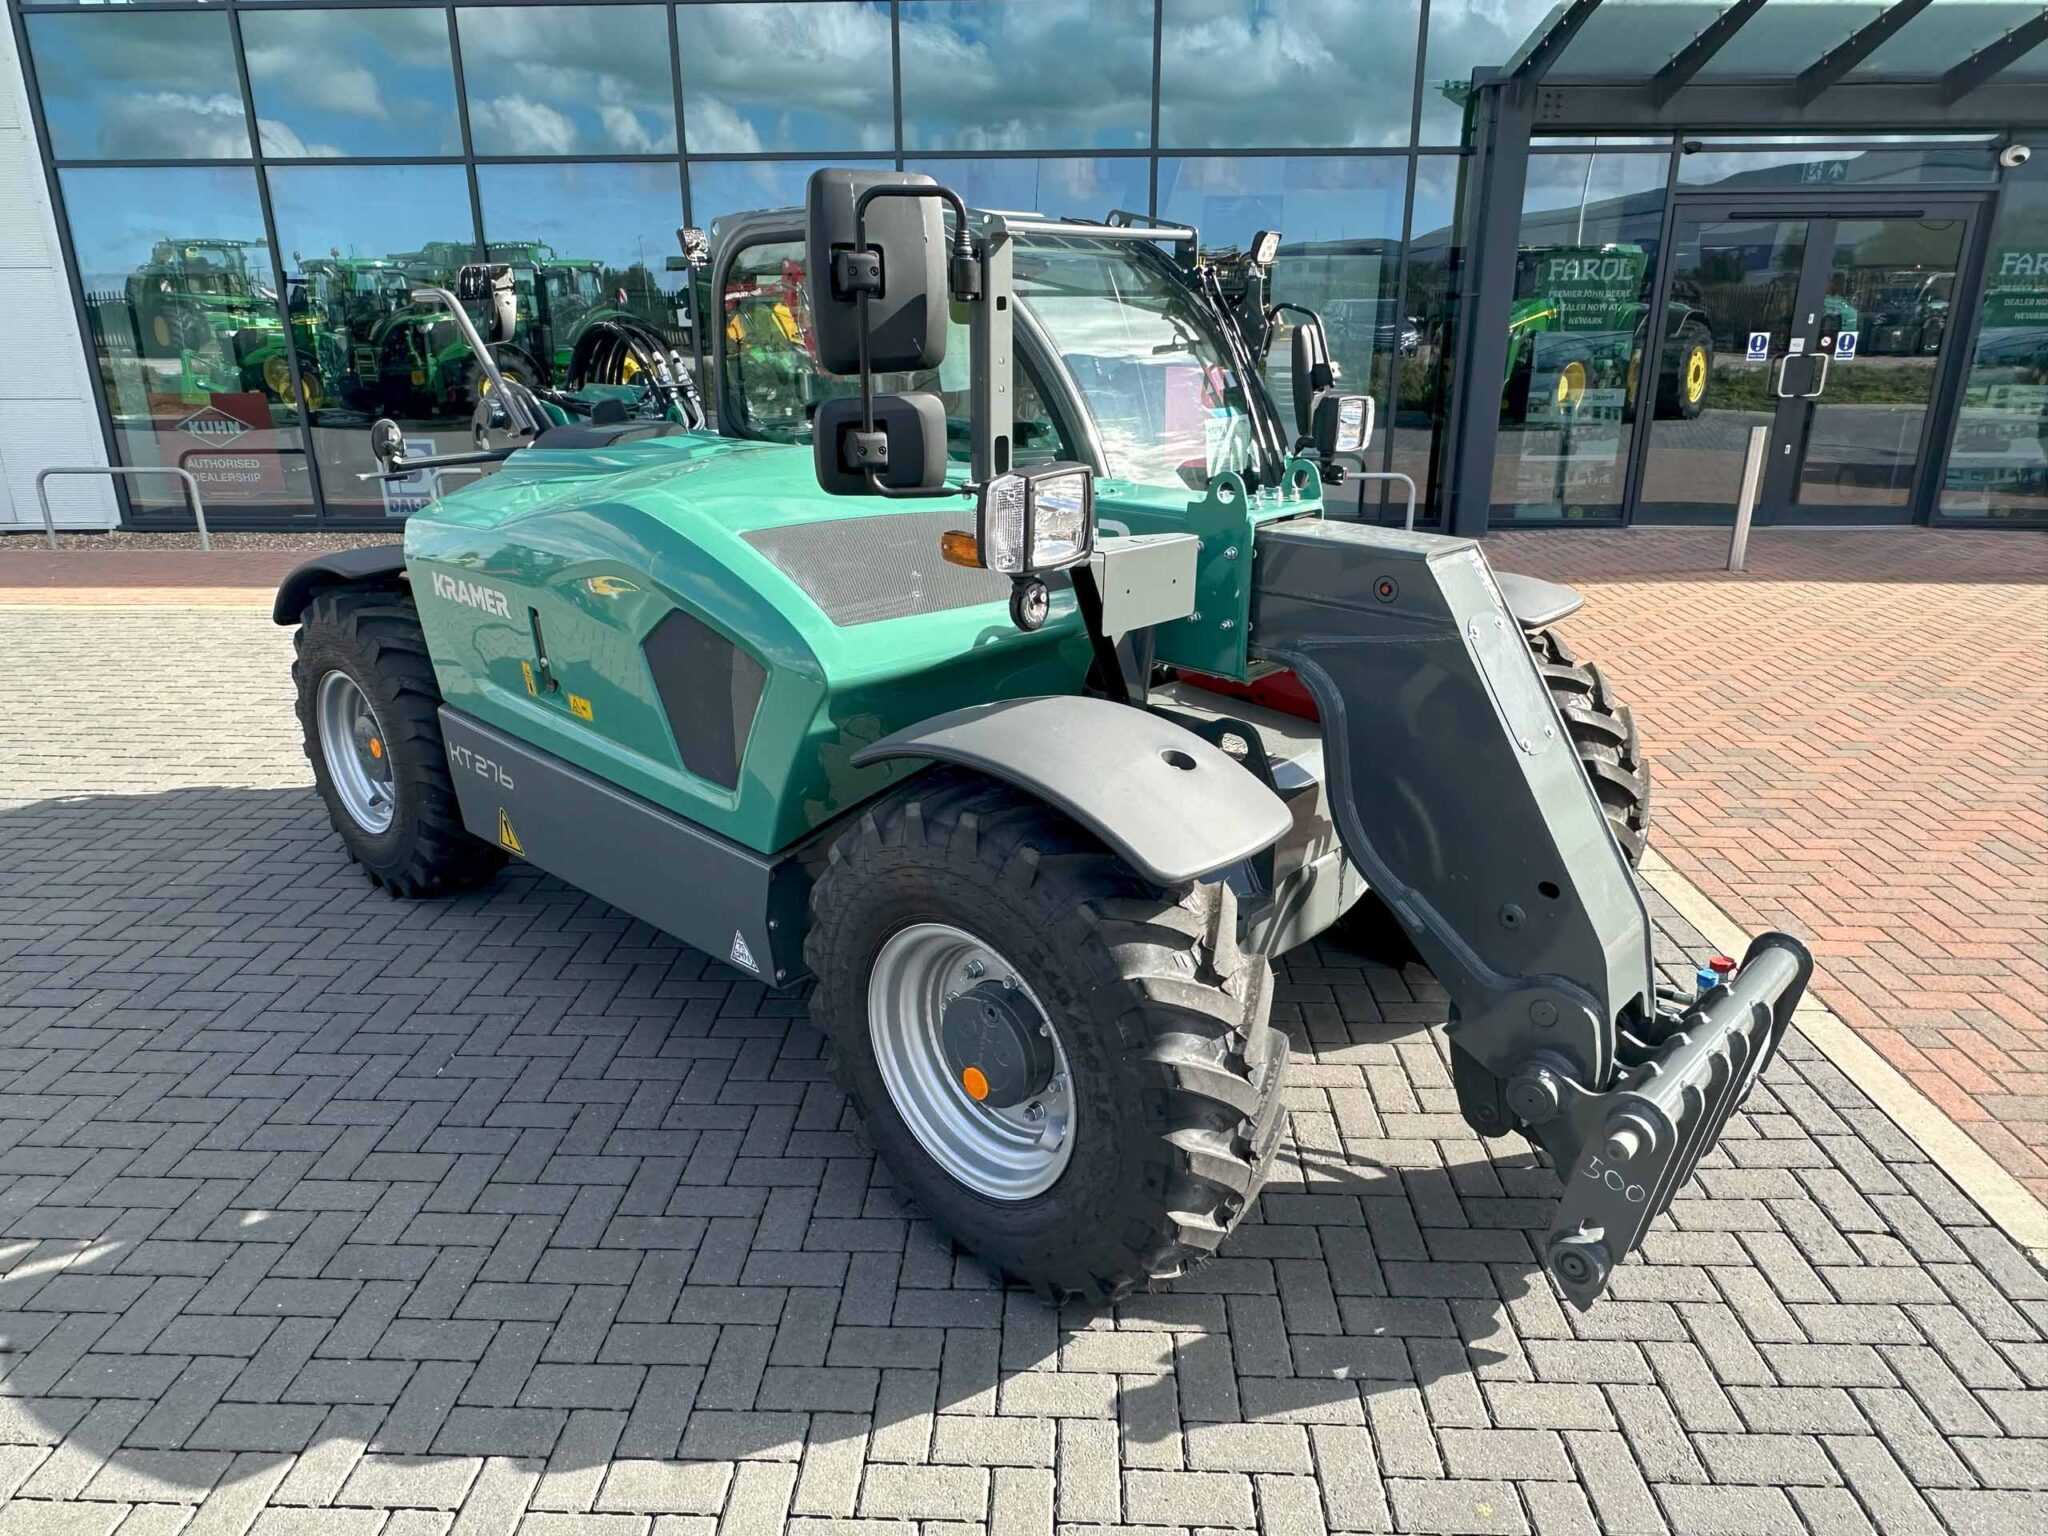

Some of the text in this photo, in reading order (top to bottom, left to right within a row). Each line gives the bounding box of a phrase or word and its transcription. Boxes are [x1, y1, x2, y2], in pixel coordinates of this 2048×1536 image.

[1548, 258, 1634, 281] FAROL
[1582, 289, 1604, 298] JOHN
[1605, 289, 1631, 298] DEERE
[1587, 302, 1607, 311] NOW
[1608, 302, 1618, 311] AT
[2003, 298, 2034, 306] DEALER
[1568, 317, 1603, 325] NEWARK
[187, 420, 241, 435] KUHN
[187, 458, 261, 469] AUTHORISED
[191, 472, 262, 482] DEALERSHIP
[432, 571, 512, 620] KRAMER
[1581, 1155, 1646, 1203] 500
